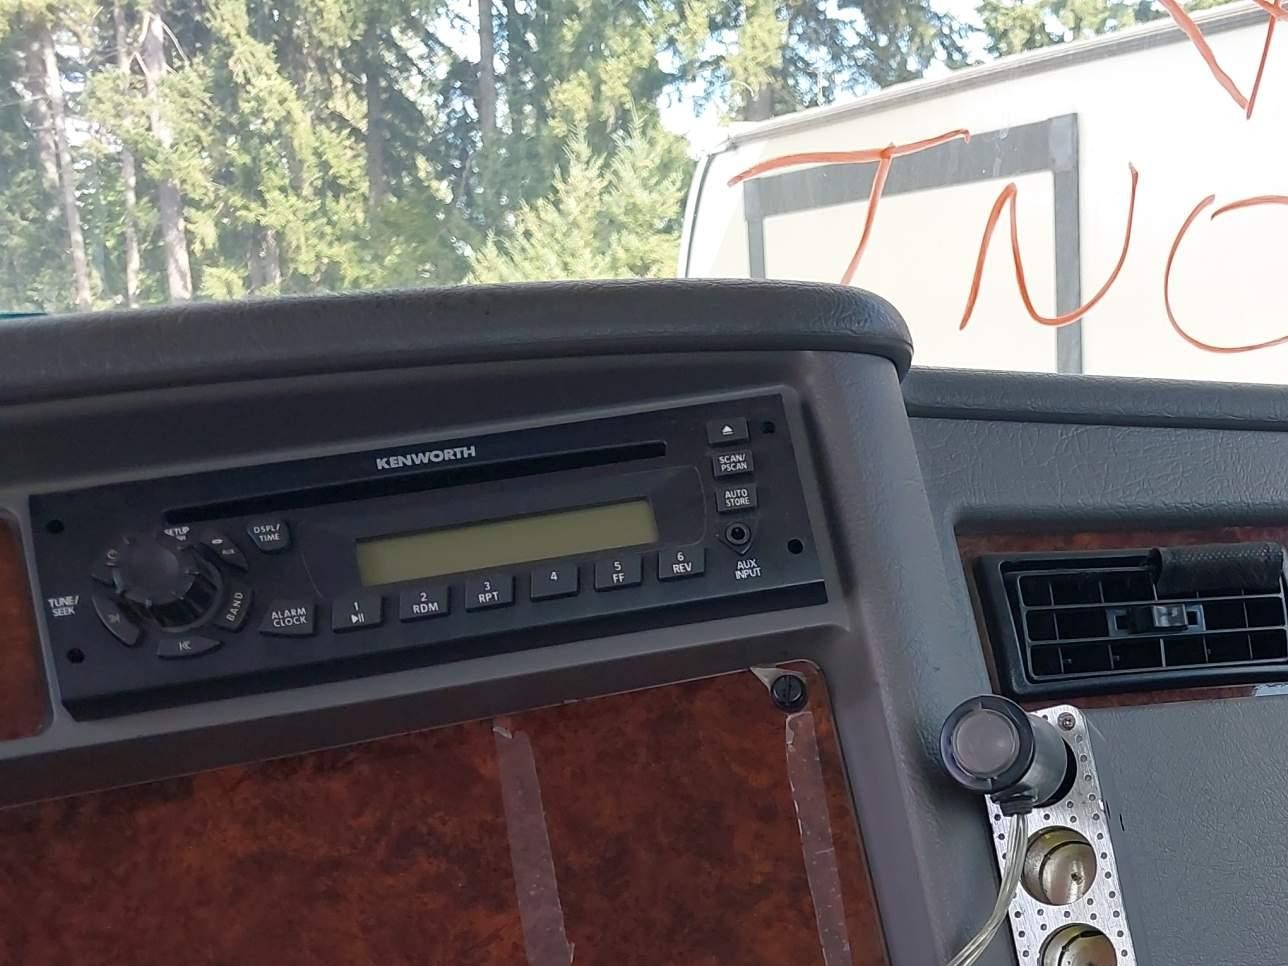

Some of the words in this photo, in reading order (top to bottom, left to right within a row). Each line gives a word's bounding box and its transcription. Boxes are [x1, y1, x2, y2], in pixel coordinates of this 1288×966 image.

[376, 445, 476, 470] KENWORTH
[719, 453, 746, 464] SCAN/
[721, 461, 748, 472] PSCAN
[725, 489, 748, 499] AUTO
[726, 497, 751, 507] STORE
[253, 524, 280, 534] DSPL/
[259, 533, 280, 542] TIME
[677, 552, 684, 561] 6
[614, 561, 621, 571] 5
[672, 562, 692, 573] REV
[737, 559, 757, 569] AUX
[550, 571, 558, 581] 4
[613, 573, 625, 584] FF
[735, 567, 761, 580] INPUT
[484, 581, 491, 591] 3
[48, 595, 79, 608] TUNE/
[420, 592, 427, 602] 2
[478, 591, 499, 603] RPT
[52, 605, 76, 617] SEEK
[226, 591, 244, 622] BAND
[353, 602, 359, 611] 1
[412, 602, 439, 614] RDM
[271, 607, 307, 620] ALARM
[273, 615, 307, 627] CLOCK
